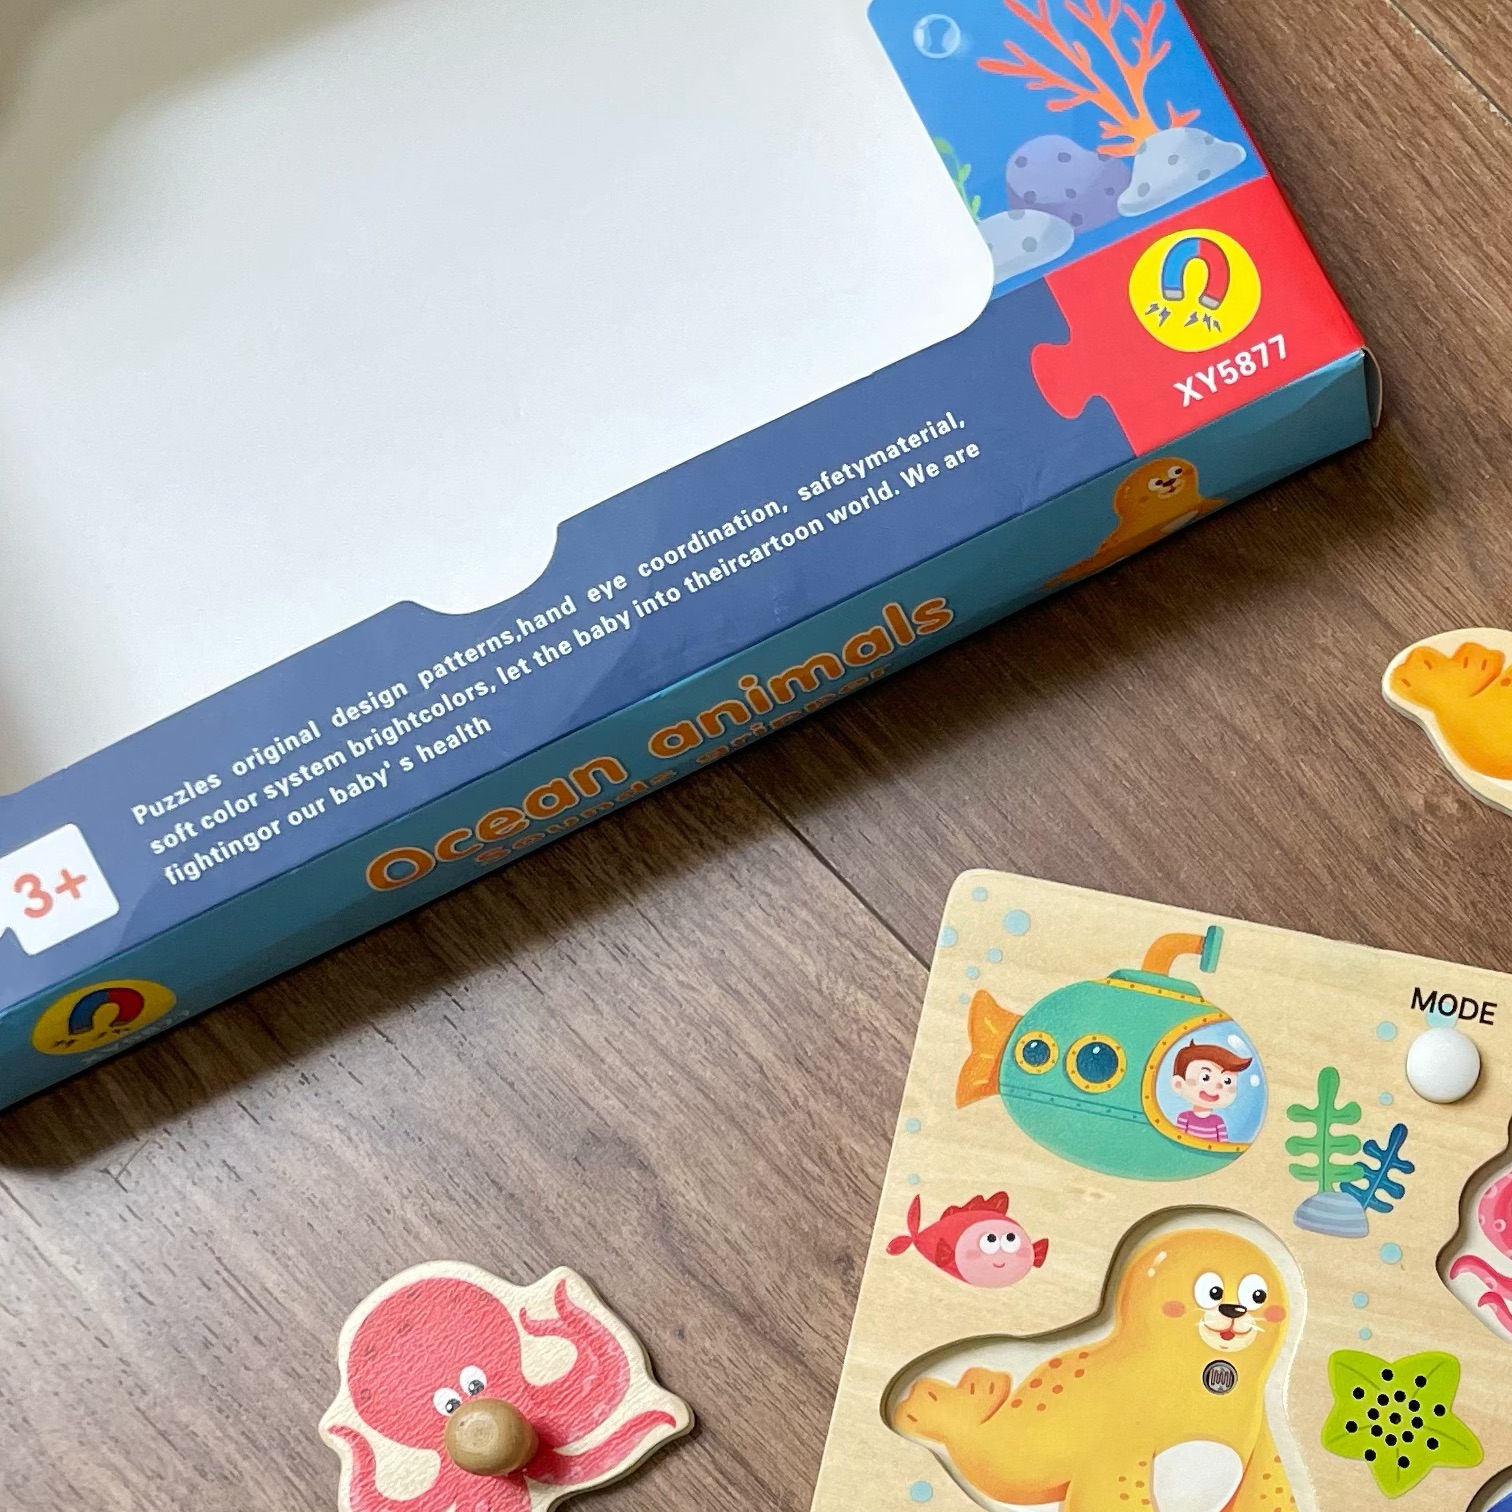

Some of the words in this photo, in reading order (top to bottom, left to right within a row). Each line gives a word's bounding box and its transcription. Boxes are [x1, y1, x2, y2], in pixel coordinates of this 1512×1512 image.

[1173, 334, 1286, 407] XY5877
[131, 773, 222, 825] Puzzles
[232, 720, 321, 776] original
[331, 682, 408, 727] design
[587, 575, 628, 603] eye
[638, 501, 788, 577] coordination,
[797, 411, 965, 501] safetymaterial,
[150, 822, 199, 854] soft
[200, 793, 258, 830] color
[263, 750, 347, 799] system
[347, 681, 497, 758] brightcolors,
[496, 657, 532, 685] let
[532, 640, 572, 667] the
[573, 610, 631, 647] baby
[632, 587, 681, 618] into
[684, 518, 824, 593] theircartoon
[826, 480, 900, 525] world.
[900, 463, 940, 488] We
[943, 443, 980, 470] are
[164, 820, 281, 885] fightingor
[287, 798, 326, 826] our
[416, 717, 492, 763] health
[366, 756, 628, 891] Ocean
[648, 597, 954, 759] animals
[14, 868, 86, 918] 3+
[1411, 987, 1497, 1026] MODE
